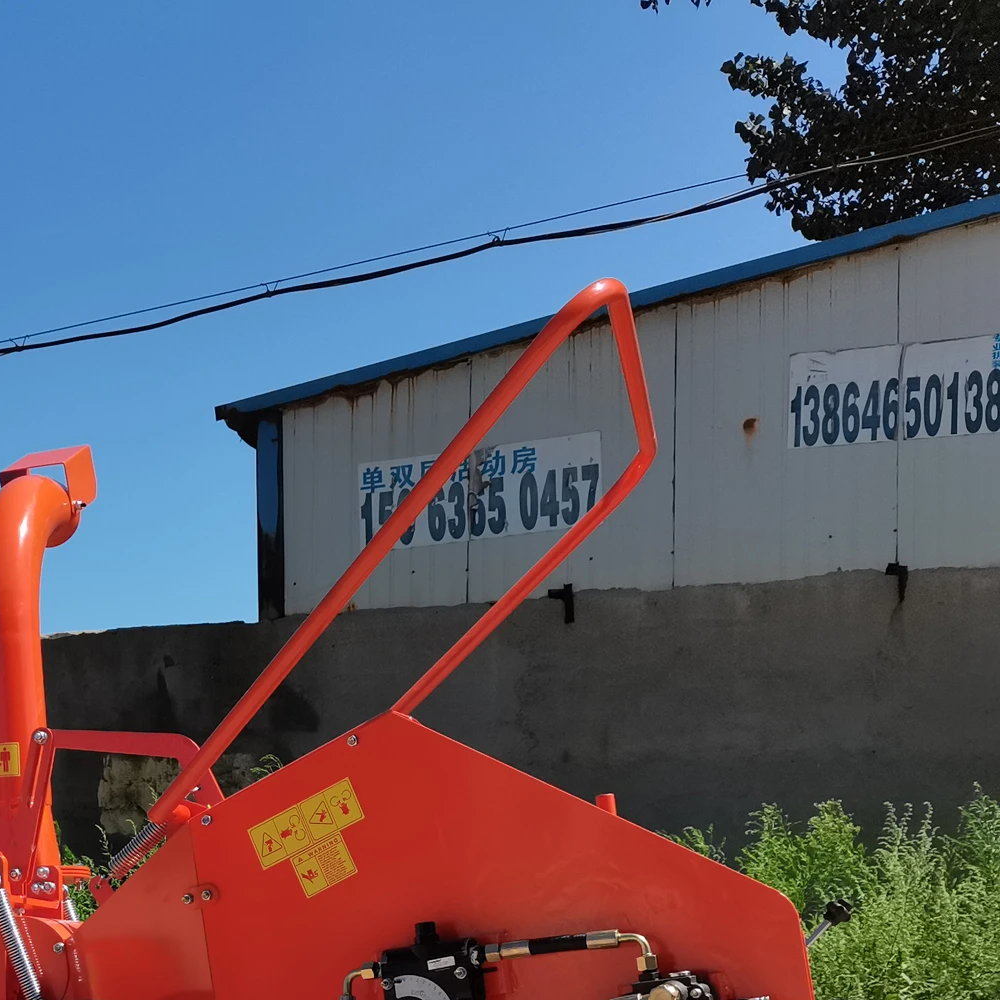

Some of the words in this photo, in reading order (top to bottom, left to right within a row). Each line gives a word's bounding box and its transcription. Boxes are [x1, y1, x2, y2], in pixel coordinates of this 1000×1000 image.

[790, 368, 1000, 448] 13864650138
[519, 463, 600, 531] 0457
[307, 837, 339, 857] WARNING
